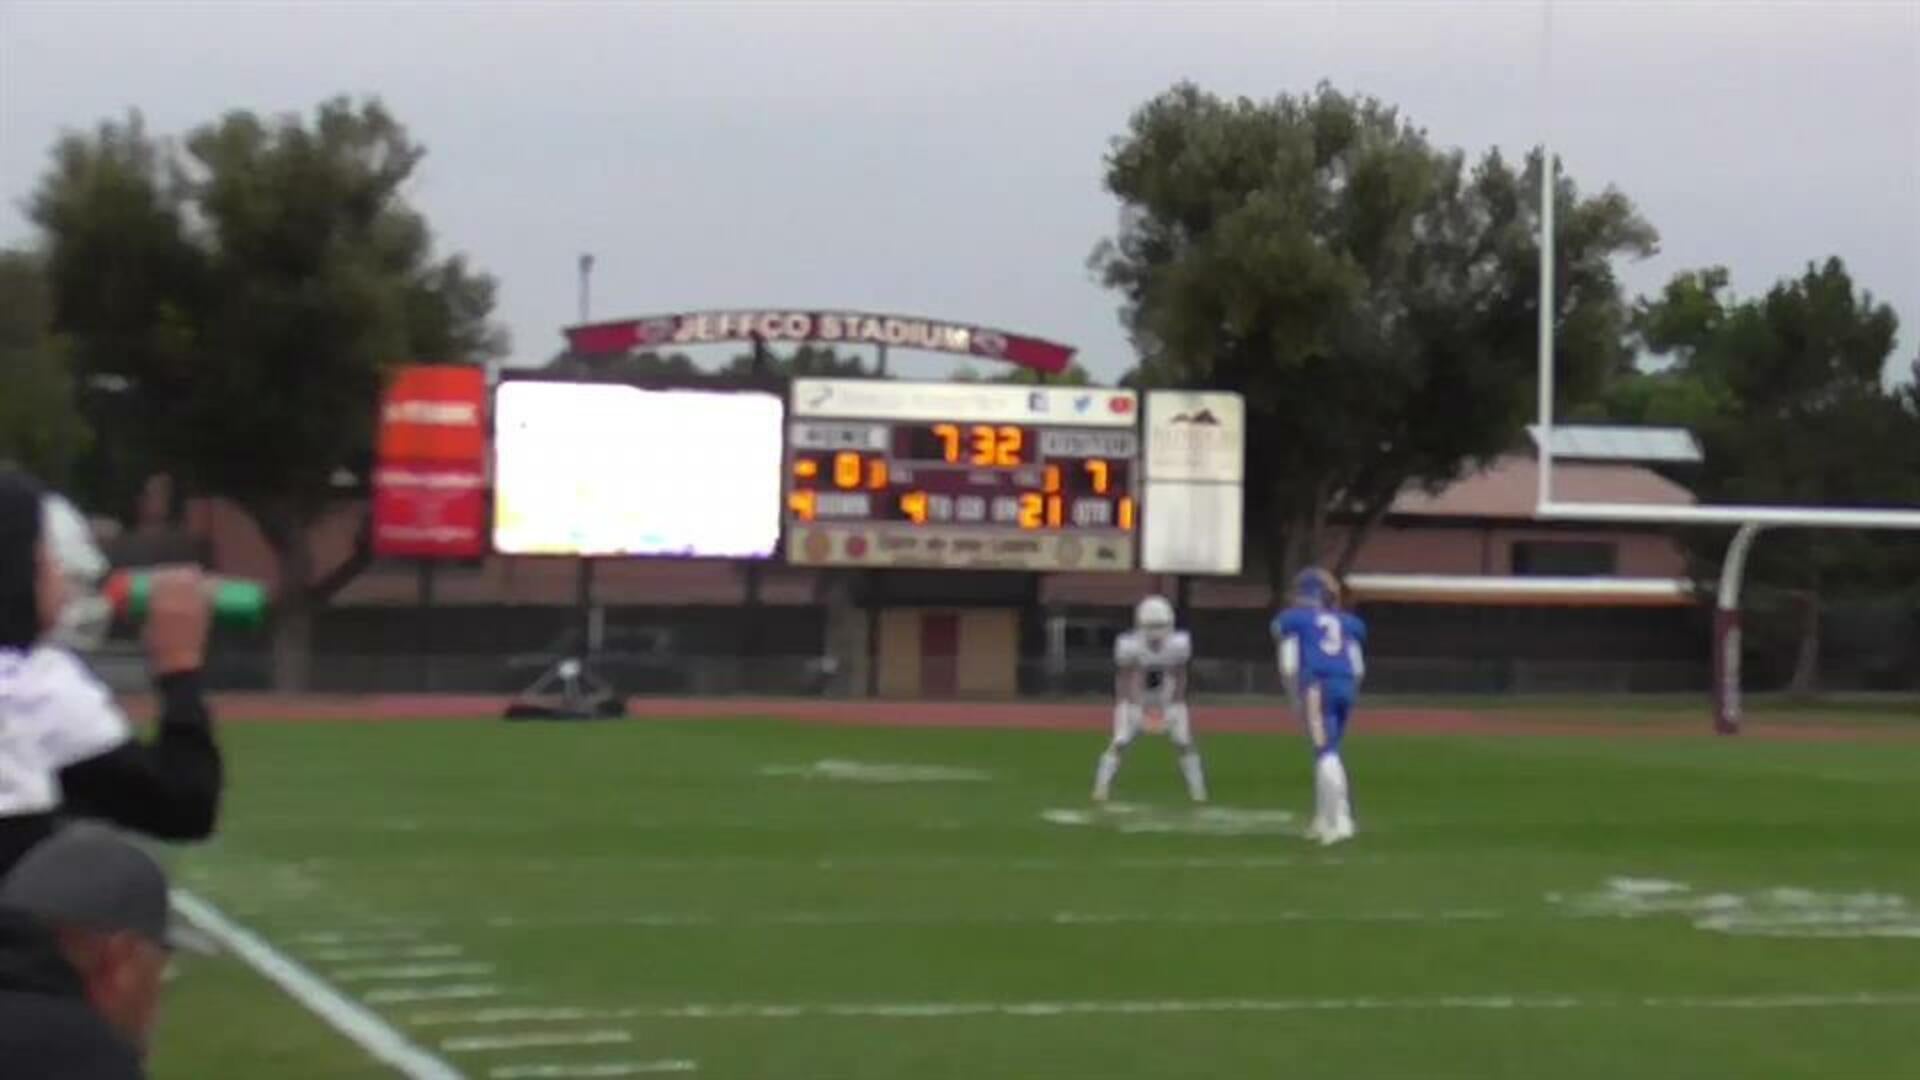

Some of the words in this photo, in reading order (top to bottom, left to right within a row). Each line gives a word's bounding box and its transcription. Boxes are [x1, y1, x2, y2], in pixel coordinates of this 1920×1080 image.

[674, 311, 811, 343] JEFFCO
[821, 313, 970, 353] STADIUM
[834, 451, 862, 489] 0
[1085, 458, 1108, 495] 7
[788, 490, 816, 522] 4
[900, 490, 929, 526] 4
[1018, 492, 1063, 529] 21
[1117, 496, 1134, 531] 1
[1316, 613, 1342, 657] 3
